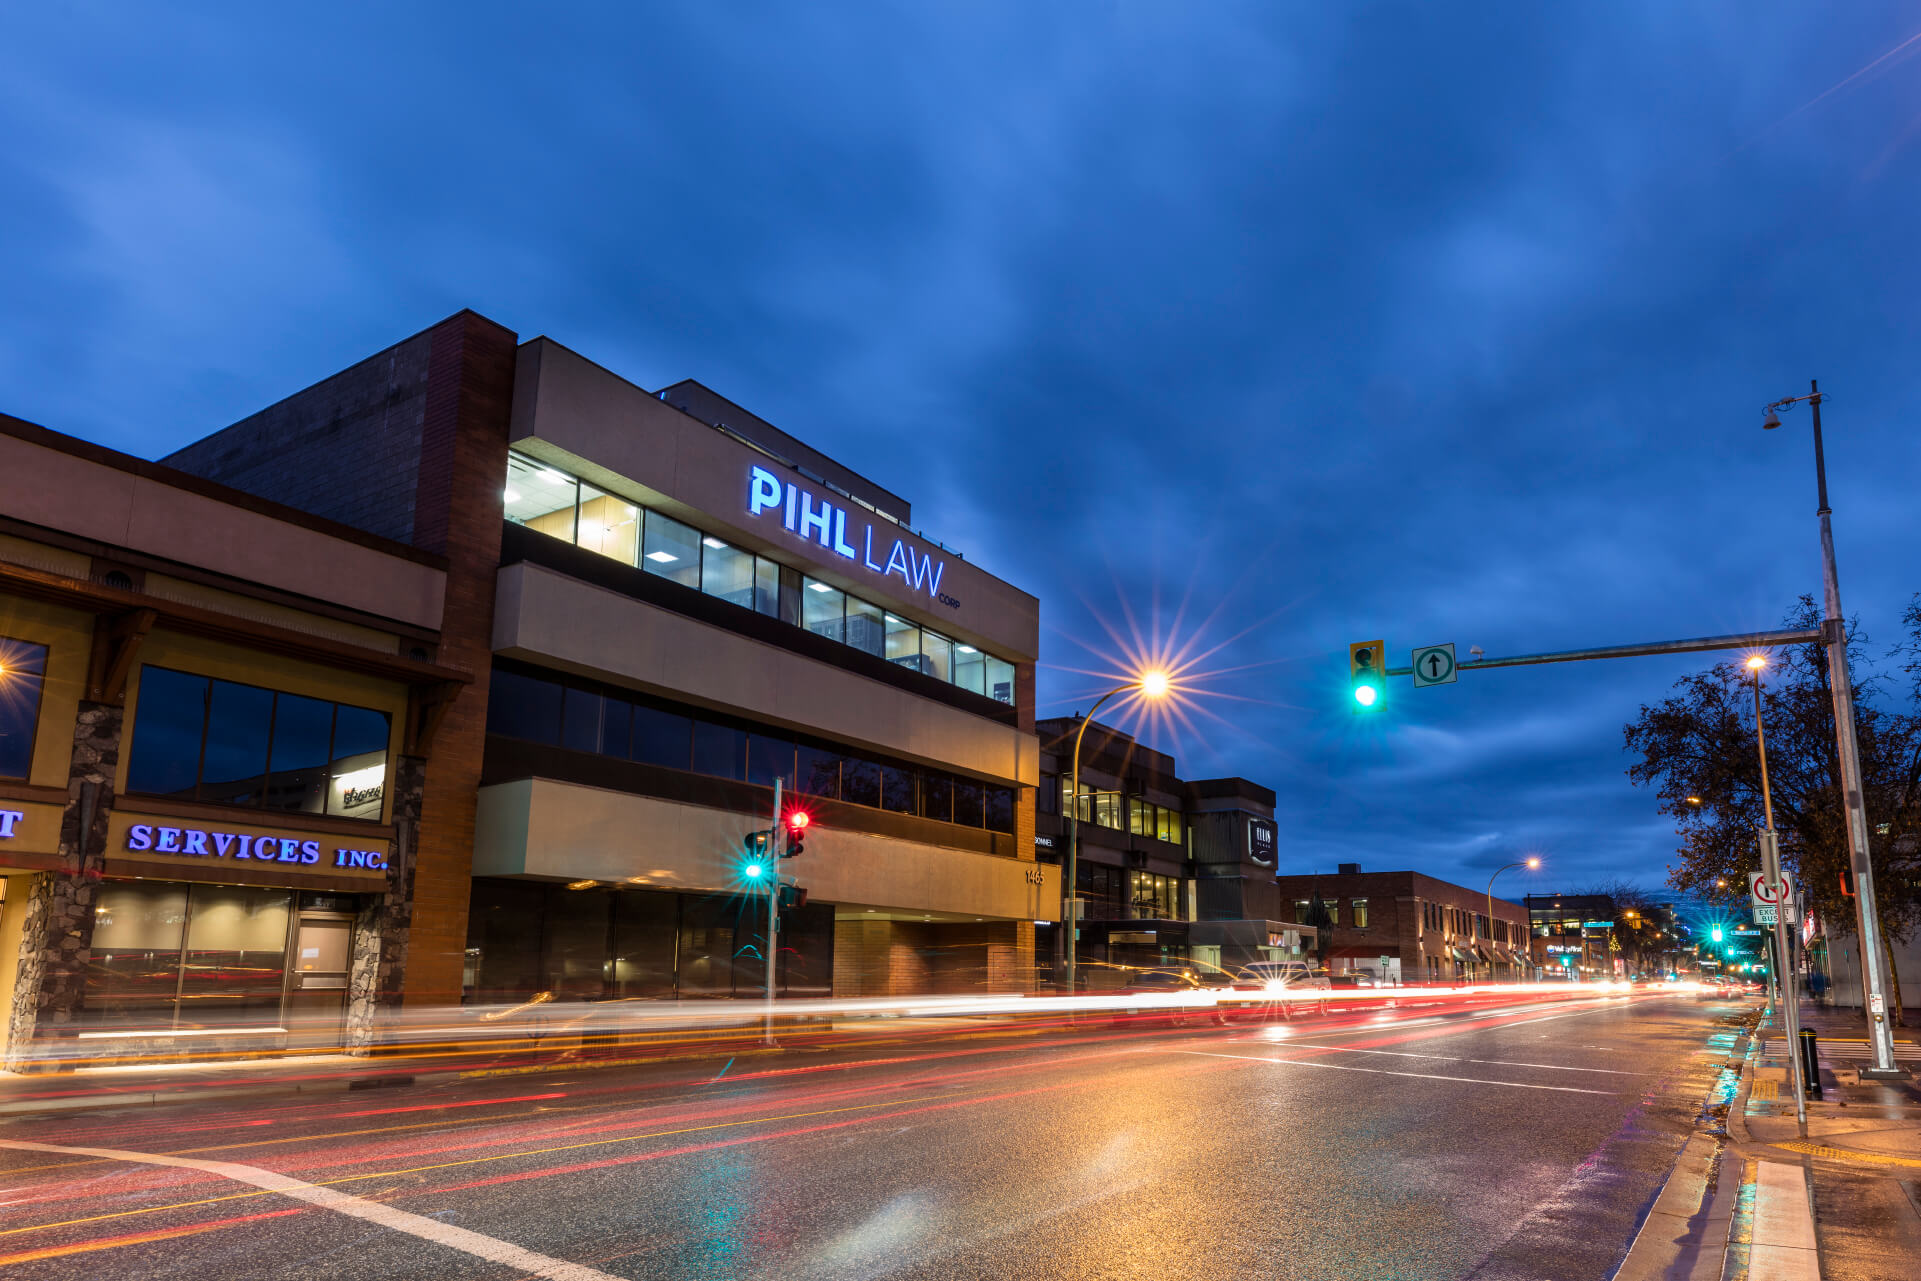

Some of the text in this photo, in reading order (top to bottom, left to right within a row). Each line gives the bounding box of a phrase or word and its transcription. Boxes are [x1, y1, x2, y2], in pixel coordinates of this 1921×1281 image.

[750, 465, 944, 597] PIHL LAW
[938, 592, 961, 609] CORP
[129, 824, 389, 870] SERVICES INC.
[1026, 870, 1045, 887] 1465
